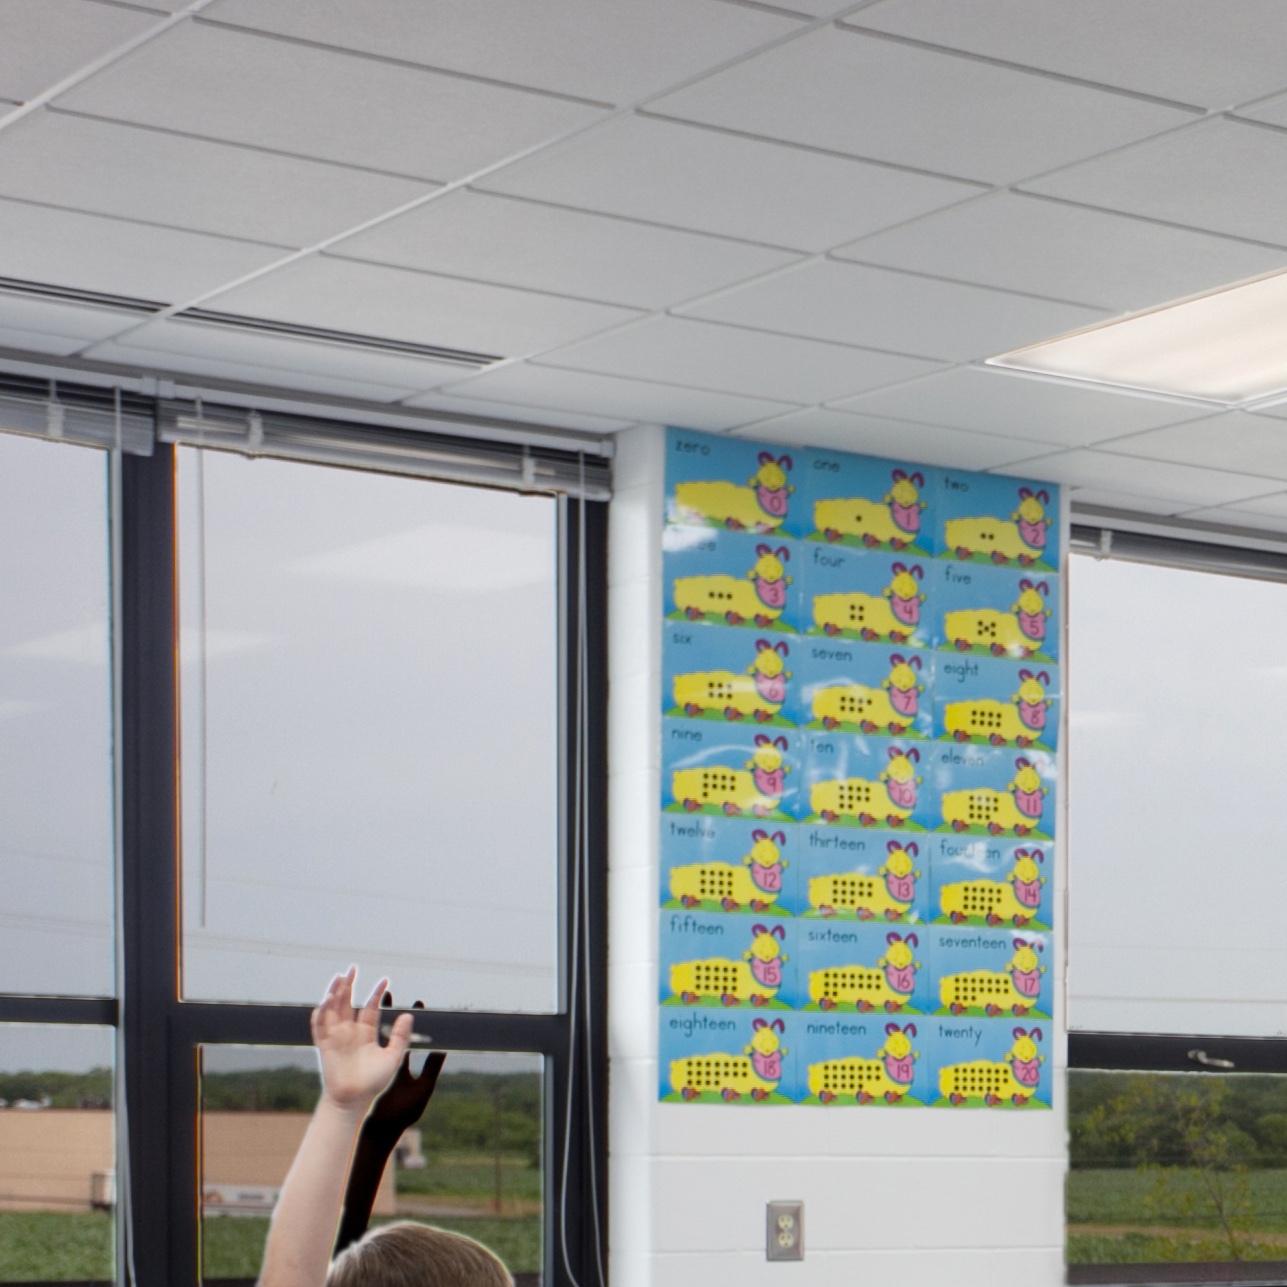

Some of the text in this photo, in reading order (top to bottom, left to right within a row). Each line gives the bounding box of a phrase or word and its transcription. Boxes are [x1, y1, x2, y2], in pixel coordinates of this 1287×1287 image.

[675, 438, 711, 457] zero
[813, 458, 840, 473] one
[944, 477, 969, 493] two
[769, 494, 782, 513] 0
[904, 511, 912, 528] 1
[1031, 527, 1041, 545] 2
[813, 551, 845, 568] four
[945, 567, 972, 585] five
[769, 587, 779, 603] 3
[903, 604, 913, 621] 4
[1030, 617, 1040, 636] 5
[672, 633, 692, 646] six
[812, 648, 853, 663] seven
[944, 663, 979, 683] eight
[768, 681, 779, 699] 6
[903, 695, 912, 711] 7
[1030, 709, 1040, 725] 8
[671, 728, 703, 742] nine
[810, 739, 834, 754] ten
[767, 777, 777, 793] 9
[898, 787, 913, 805] 10
[1026, 797, 1039, 813] 11
[670, 822, 715, 840] twelve
[809, 833, 865, 851] thirteen
[763, 872, 778, 889] 12
[897, 881, 911, 898] 13
[1024, 888, 1038, 904] 14
[670, 918, 724, 936] fifteen
[808, 929, 858, 944] sixteen
[939, 936, 1006, 950] seventeen
[763, 966, 778, 982] 15
[897, 973, 911, 989] 16
[1024, 976, 1035, 993] 17
[669, 1017, 736, 1037] eighteen
[807, 1021, 866, 1037] nineteen
[939, 1025, 983, 1049] twenty
[763, 1059, 778, 1076] 18
[896, 1064, 910, 1080] 19
[1022, 1066, 1039, 1082] 20
